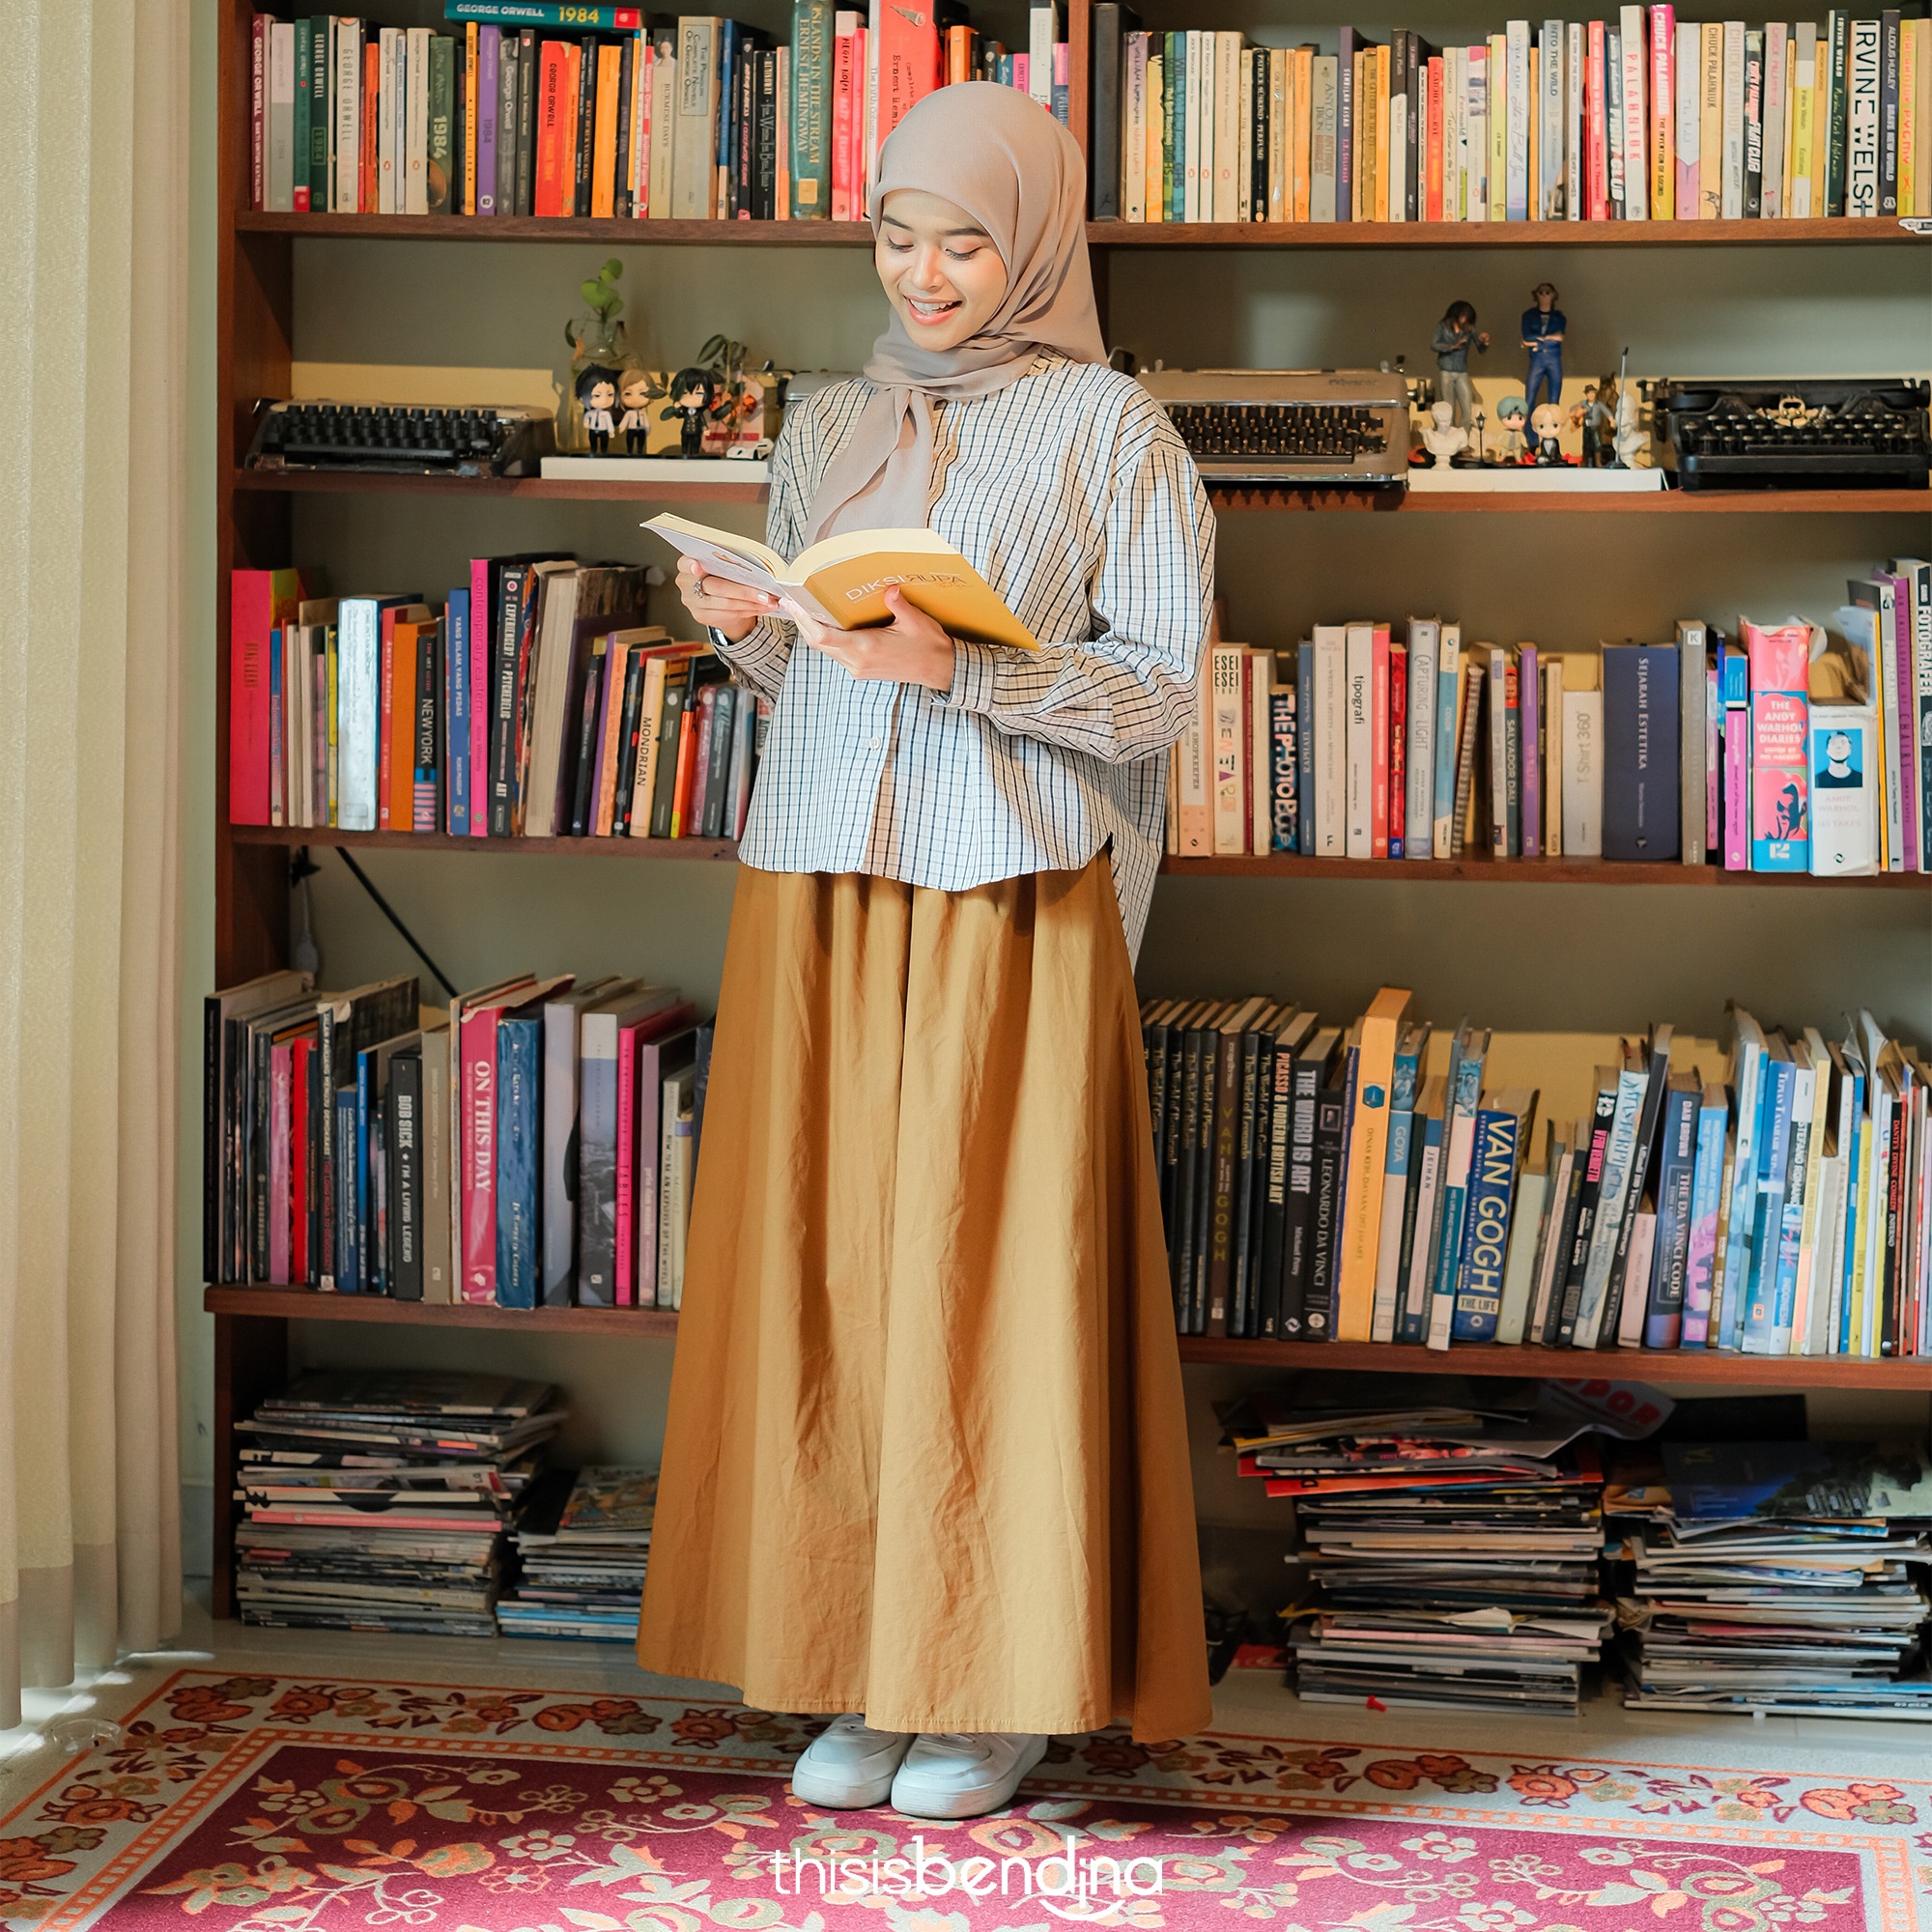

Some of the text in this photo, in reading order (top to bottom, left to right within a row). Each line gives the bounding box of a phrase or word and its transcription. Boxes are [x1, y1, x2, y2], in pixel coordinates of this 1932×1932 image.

[457, 4, 545, 16] GEORGE ORWELL
[558, 6, 599, 23] 1984
[1549, 24, 1558, 97] INTO THE WILD
[1887, 26, 1896, 57] ALDOUS
[315, 34, 325, 99] GEORGE ORWELL
[503, 66, 514, 99] George
[763, 61, 772, 95] HEMINGWAY
[892, 54, 901, 93] Ernest
[905, 62, 915, 99] Complete
[1653, 13, 1669, 116] CHUCK PALAHNIUK
[1707, 28, 1718, 108] CHUCK PALAHNIUK
[1727, 28, 1740, 135] CHUCK PALAHNIUK
[1770, 27, 1781, 107] CHUCK PALAHNIUK
[1854, 22, 1877, 115] IRVINE
[342, 49, 354, 141] GEORGE ORWELL
[547, 63, 556, 128] GEORGE ORWELL
[797, 19, 810, 153] ERNEST HEMINGWAY
[810, 8, 822, 163] ISLANDS IN THE STREAM
[1342, 69, 1350, 102] SEMBILAN
[504, 101, 513, 129] Orwell
[1315, 105, 1324, 131] IRON
[1627, 53, 1641, 161] PALAHNIUK
[1887, 104, 1895, 129] BRAVE
[315, 131, 324, 159] 1984
[434, 116, 447, 159] 1984
[483, 118, 493, 144] 1984
[1747, 122, 1761, 173] FIGHT CLUB
[1609, 158, 1624, 201] CLUB
[1798, 148, 1806, 176] Ecstasy
[1886, 153, 1894, 182] WORLD
[473, 577, 486, 713] contemporary eastern
[503, 604, 516, 656] EXPERIENCED?
[1918, 605, 1932, 696] FOTOGRAFER
[1214, 655, 1239, 670] ESEI
[1214, 672, 1239, 687] ESEI
[1884, 639, 1897, 709] PROPAGANDA
[499, 670, 513, 719] PSYCHEDELIC
[1273, 695, 1297, 733] THE
[1351, 675, 1365, 724] tipografi
[1415, 654, 1432, 750] CAPTURING LIGHT
[1637, 658, 1649, 770] SEJARAH ESTETIKA
[1771, 700, 1791, 710] THE
[1764, 711, 1797, 722] ANDY
[637, 717, 652, 786] MONDRIAN
[1302, 729, 1311, 773] RAPHAEL
[1759, 733, 1802, 744] DIARIES
[1899, 714, 1911, 769] CHAIRS
[1507, 720, 1516, 806] SALVADOR DALI
[496, 782, 507, 798] ART
[1274, 1052, 1291, 1093] PICASSO
[398, 1095, 412, 1118] BOB
[474, 1061, 491, 1193] ON THIS DAY
[1272, 1104, 1288, 1143] MODERN
[399, 1120, 412, 1149] SICK
[1291, 1070, 1317, 1194] THE WORD IS ART
[1392, 1125, 1407, 1163] GOYA
[1678, 1100, 1692, 1157] DAN BROWN
[1794, 1122, 1807, 1163] STEFANO
[1270, 1145, 1286, 1183] BRITISH
[1424, 1151, 1435, 1189] JEIHAN
[402, 1192, 412, 1221] LIVING
[617, 1165, 629, 1217] TABLES
[1269, 1185, 1284, 1205] ART
[1470, 1119, 1516, 1293] VAN GOGH
[1889, 1179, 1898, 1211] COMEDY
[324, 1217, 330, 1227] TO
[1313, 1158, 1334, 1286] LEONARDO DA VINCI
[1669, 1174, 1690, 1298] THE DA VINCI CODE
[402, 1225, 412, 1263] LEGEND
[1461, 1297, 1495, 1312] THE LIFE
[1779, 1277, 1792, 1327] INDONESIA
